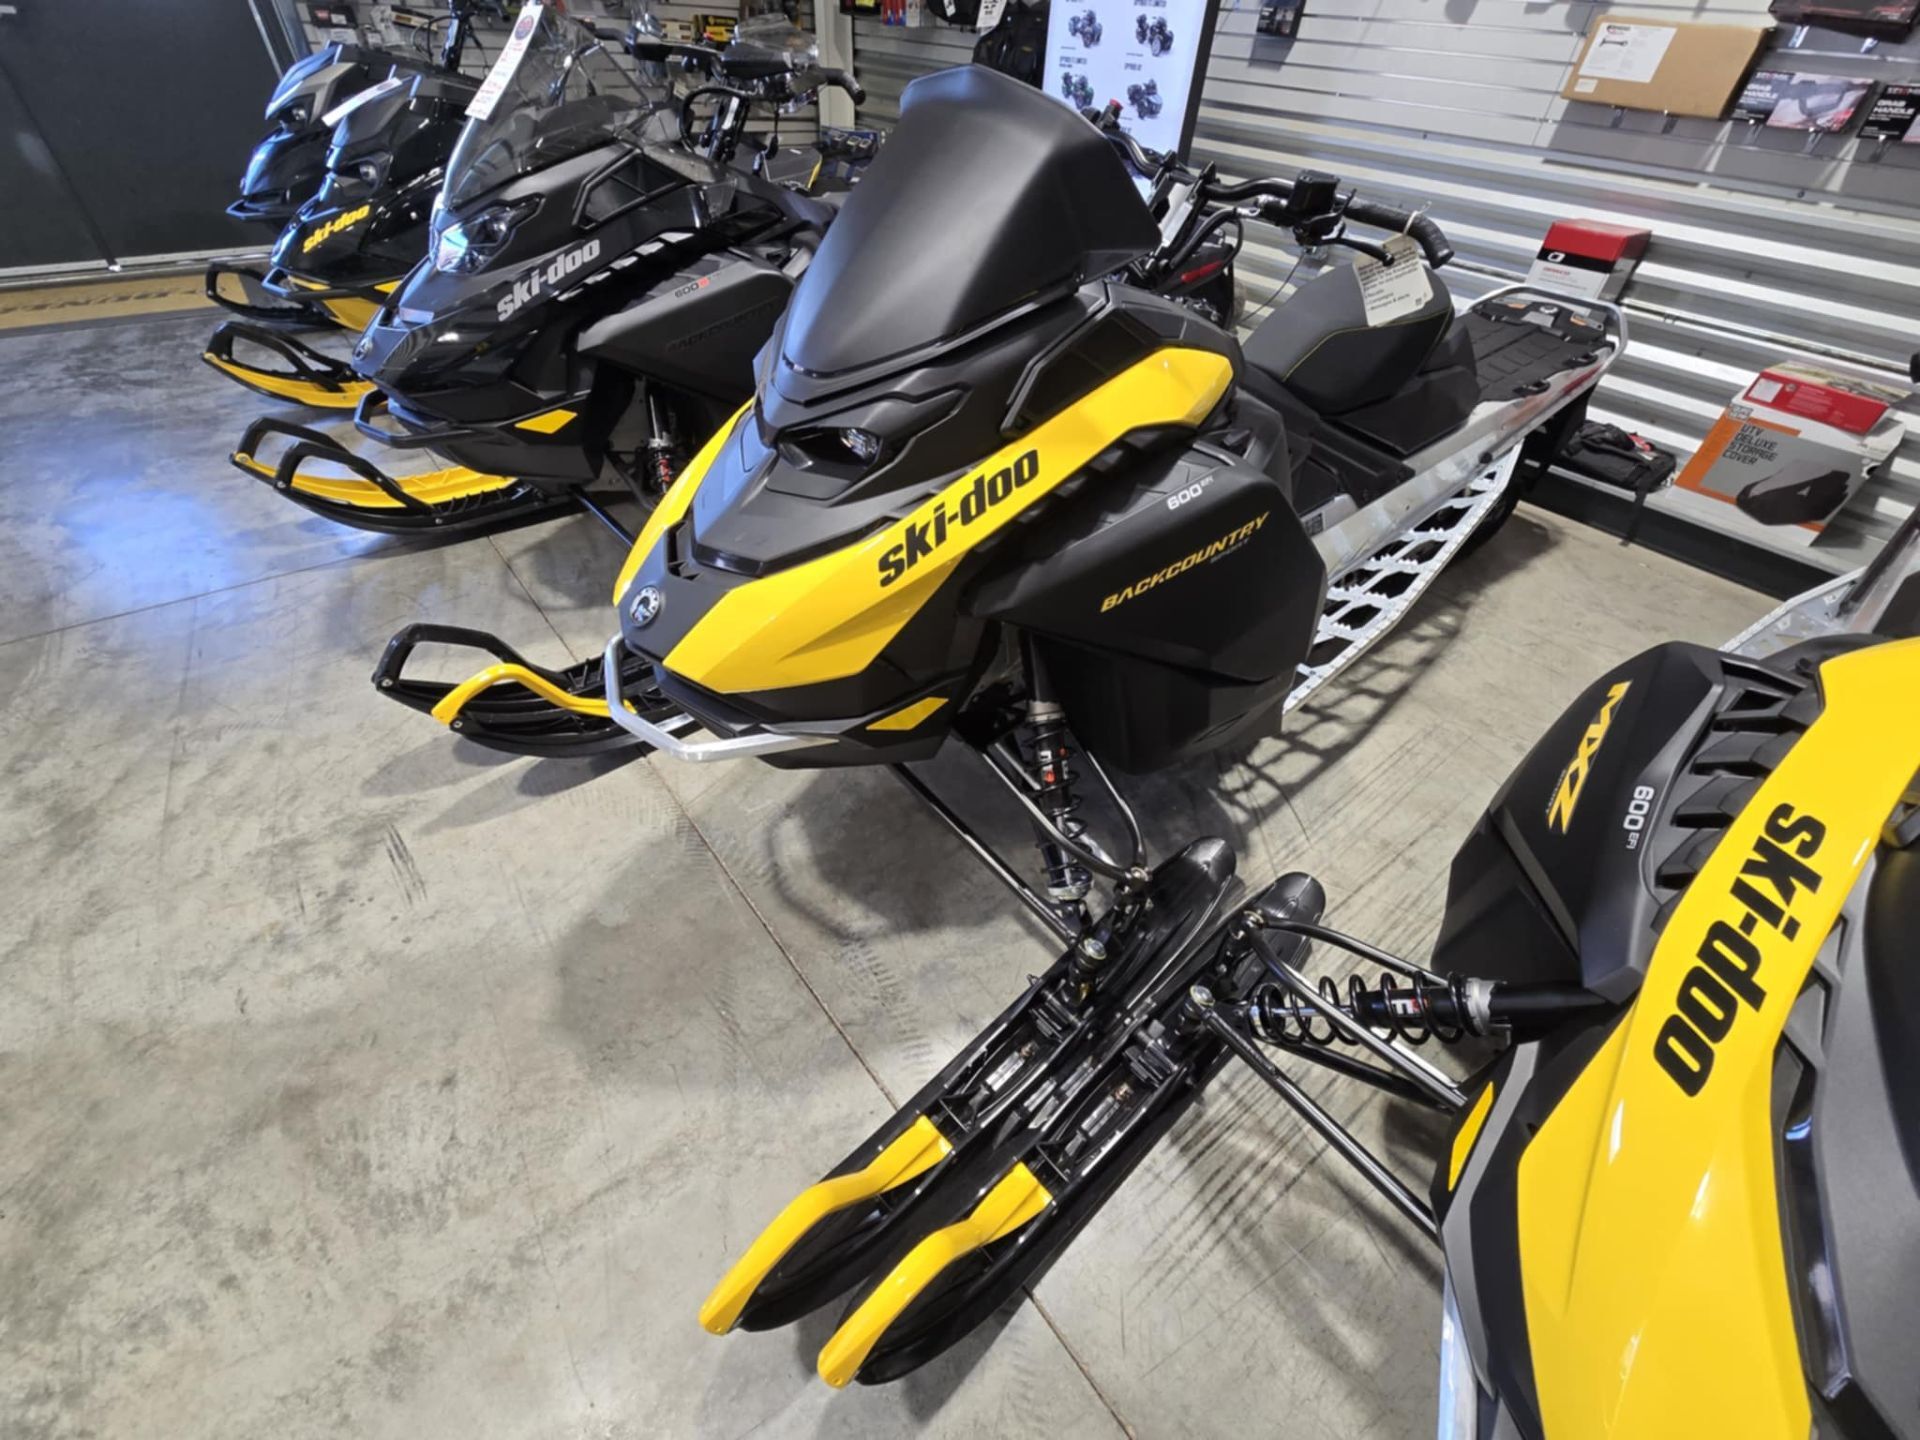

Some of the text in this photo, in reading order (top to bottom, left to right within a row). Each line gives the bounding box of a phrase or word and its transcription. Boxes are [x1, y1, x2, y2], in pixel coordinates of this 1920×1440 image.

[1873, 106, 1916, 115] HANDLE
[303, 204, 370, 253] ski-doo
[497, 239, 601, 322] ski-doo
[1730, 441, 1778, 461] STORAGE
[1734, 432, 1778, 450] DELUXE
[1741, 423, 1764, 436] UTV
[1722, 450, 1758, 465] COVER
[878, 449, 1039, 588] ski-doo
[1167, 483, 1202, 510] 600
[1100, 511, 1270, 613] BACKCOUNTRY
[1548, 681, 1632, 834] MXZ
[1623, 785, 1655, 831] 600
[1653, 803, 1827, 1098] ski-doo
